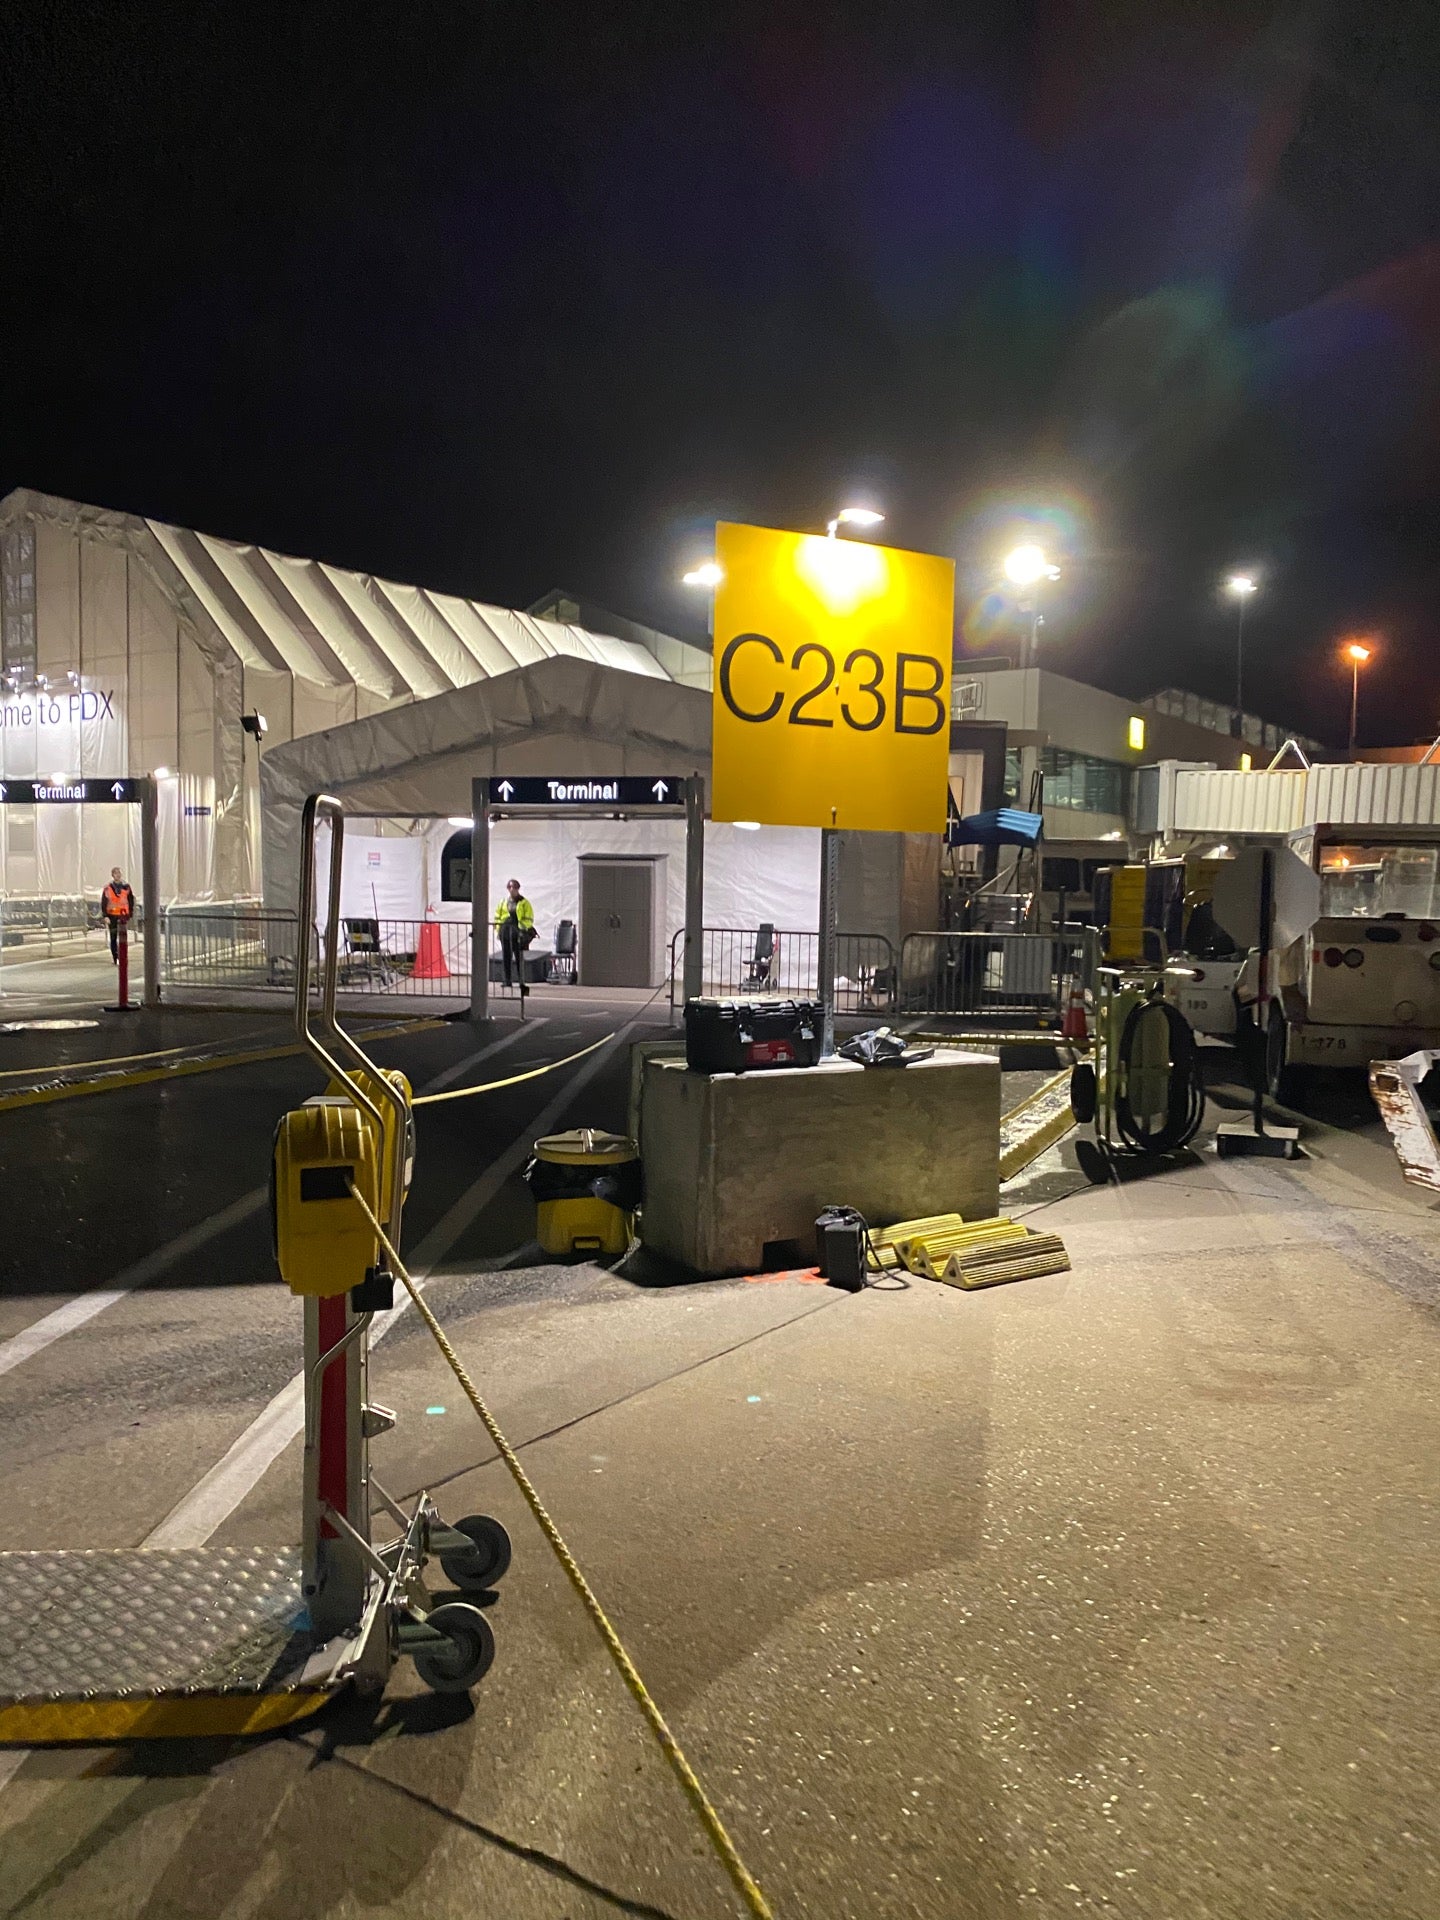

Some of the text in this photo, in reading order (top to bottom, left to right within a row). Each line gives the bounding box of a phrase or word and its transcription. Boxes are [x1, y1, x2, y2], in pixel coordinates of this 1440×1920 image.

[719, 632, 945, 735] C23B
[37, 697, 61, 724] to
[68, 689, 114, 723] PDX
[31, 783, 86, 799] Terminal
[547, 781, 618, 800] Terminal
